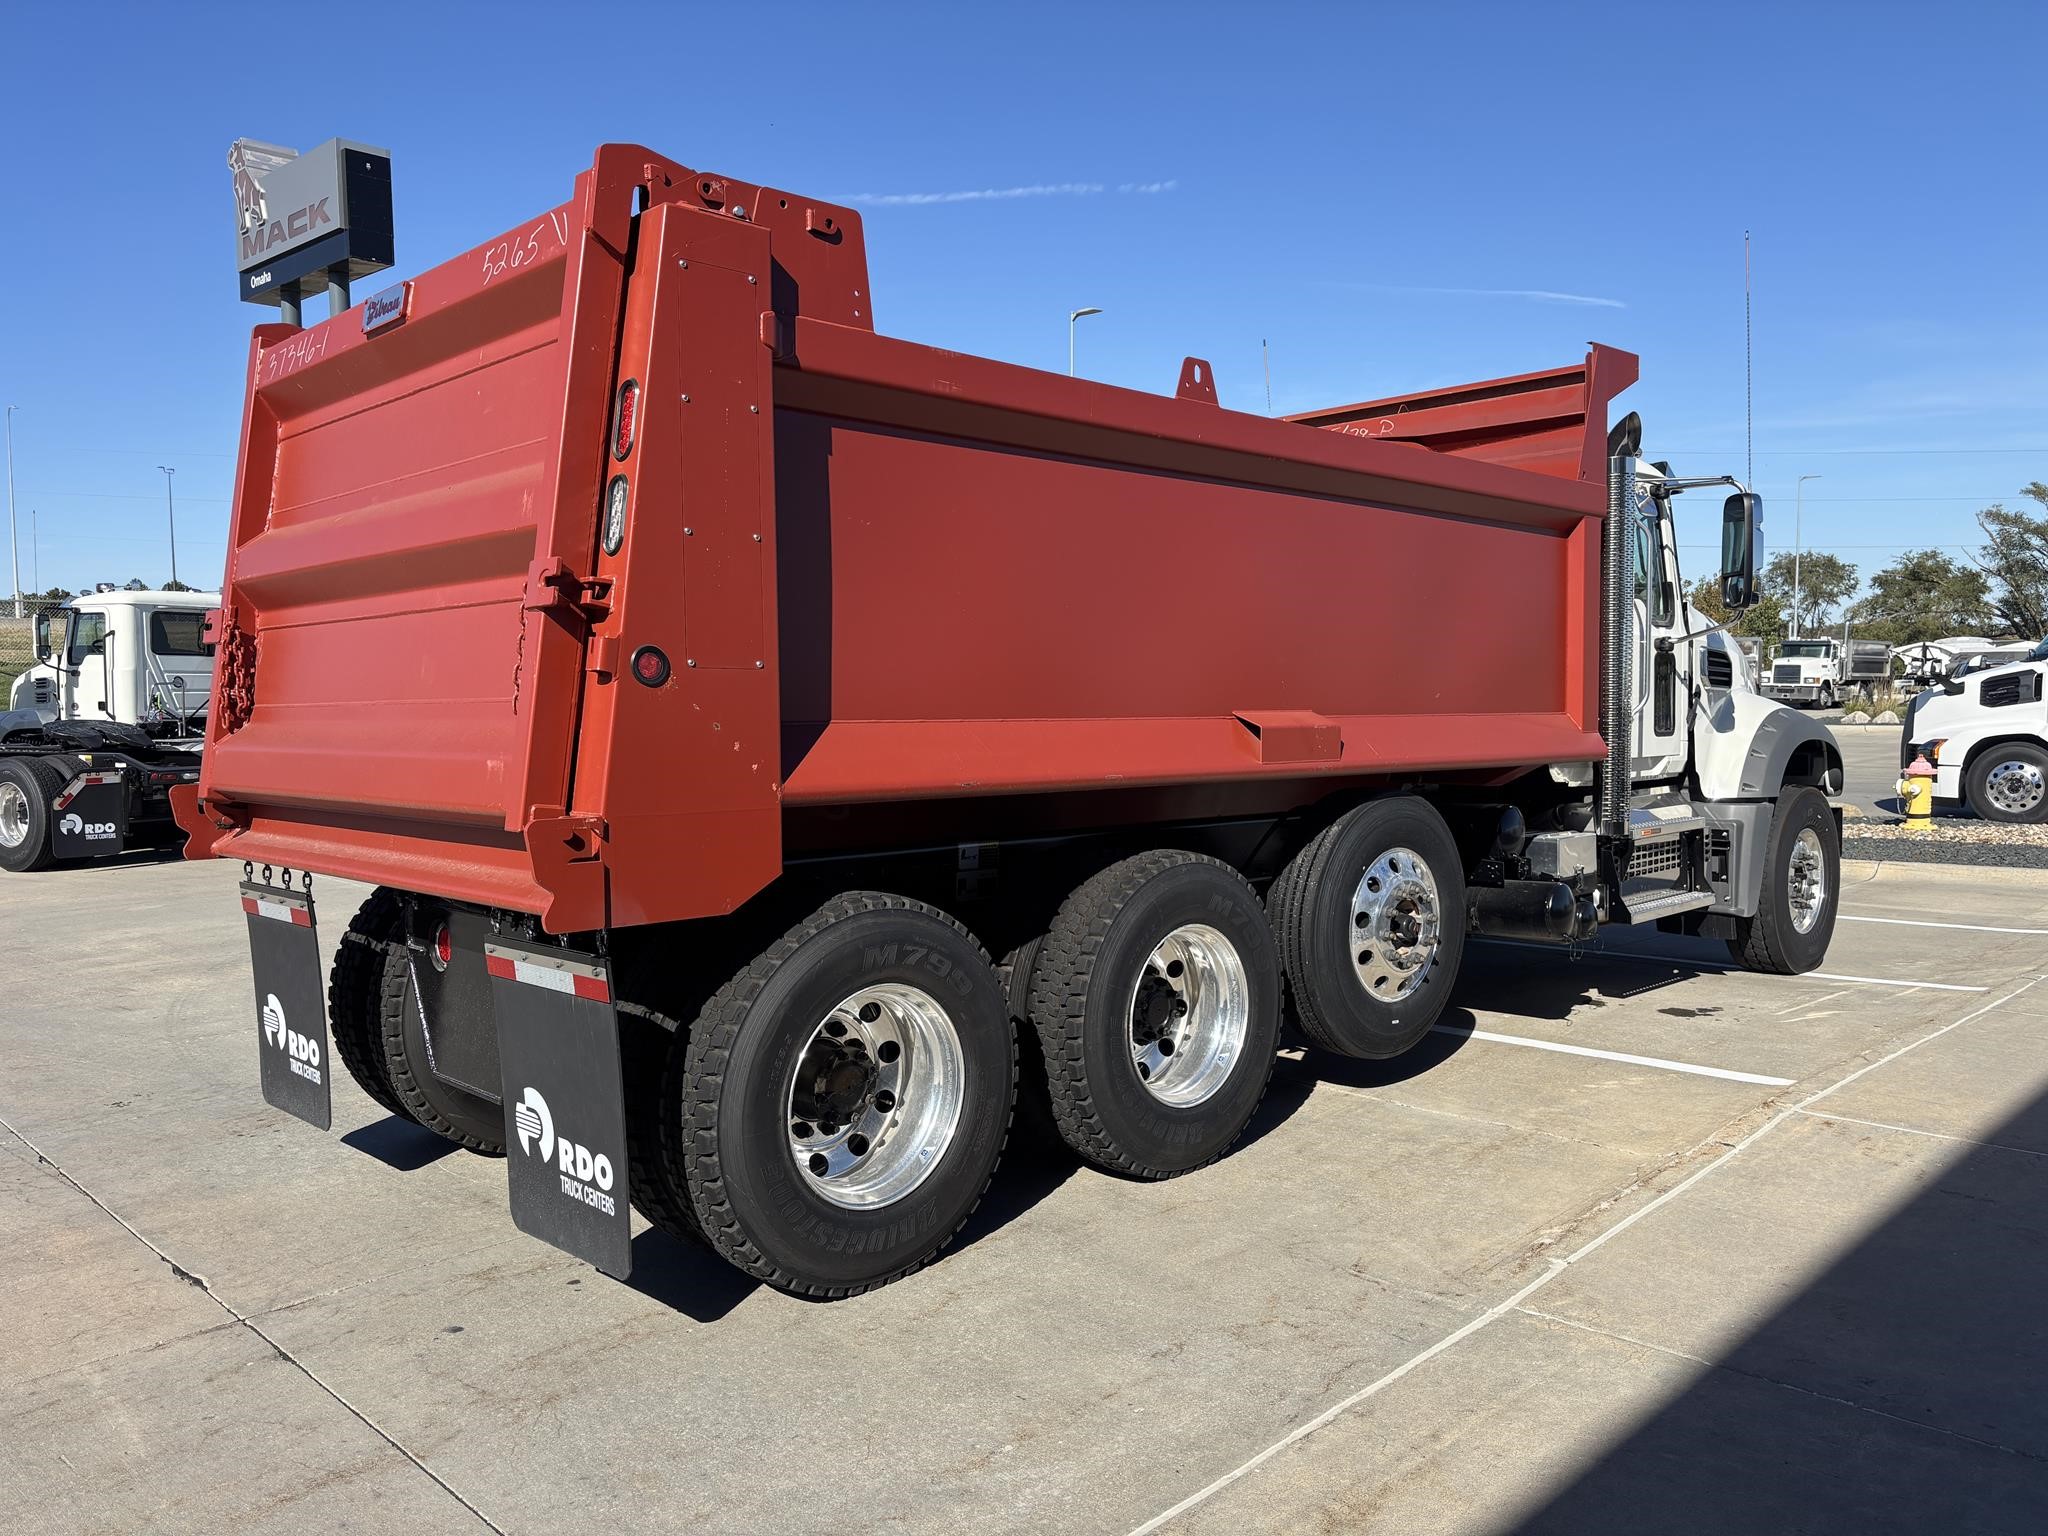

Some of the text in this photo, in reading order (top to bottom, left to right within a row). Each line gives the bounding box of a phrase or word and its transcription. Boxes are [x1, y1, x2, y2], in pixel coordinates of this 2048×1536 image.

[242, 196, 332, 261] MACK
[483, 223, 546, 286] 5265
[251, 271, 273, 289] Omaha
[268, 326, 331, 381] 37346-1
[84, 822, 116, 834] RDO
[287, 1028, 320, 1067] RDO
[289, 1056, 322, 1086] TRUCK CENTERS
[557, 1136, 614, 1191] RDO
[560, 1174, 615, 1217] TRUCK CENTERS
